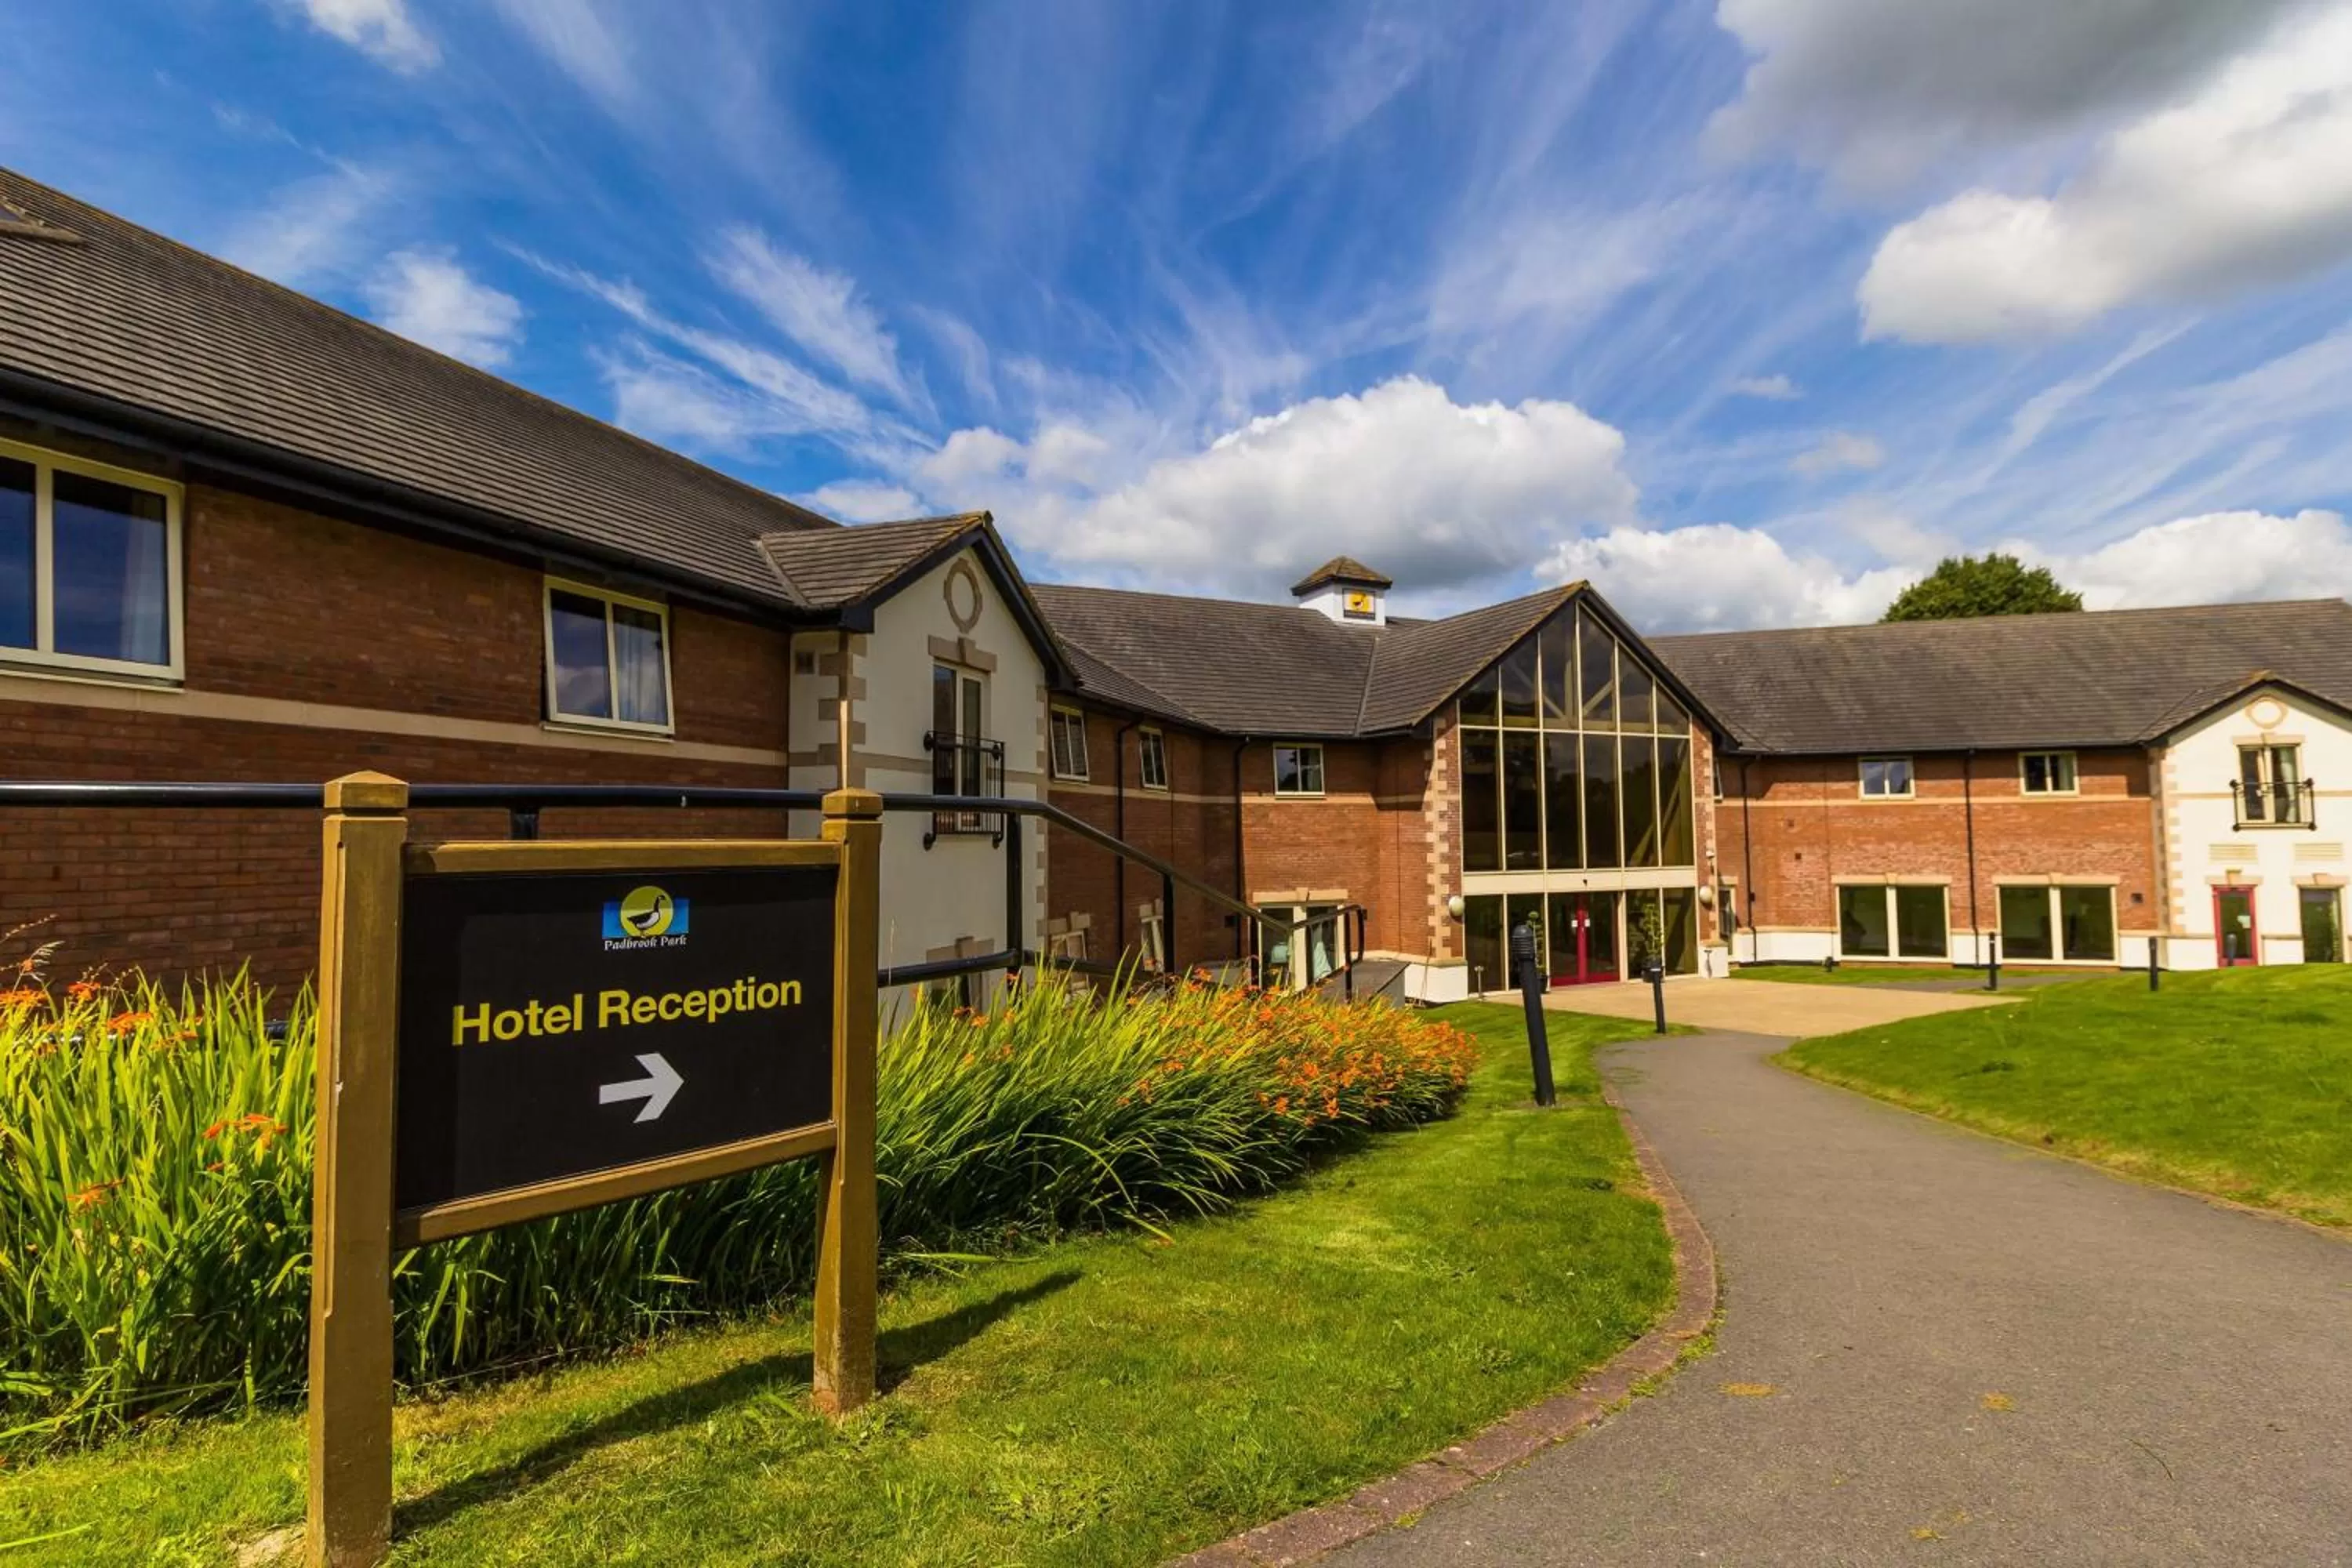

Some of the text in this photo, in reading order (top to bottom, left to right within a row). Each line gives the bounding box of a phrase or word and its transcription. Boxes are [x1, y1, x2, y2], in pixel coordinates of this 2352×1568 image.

[604, 935, 688, 951] Padbrook Park
[452, 976, 802, 1046] Hotel Reception
